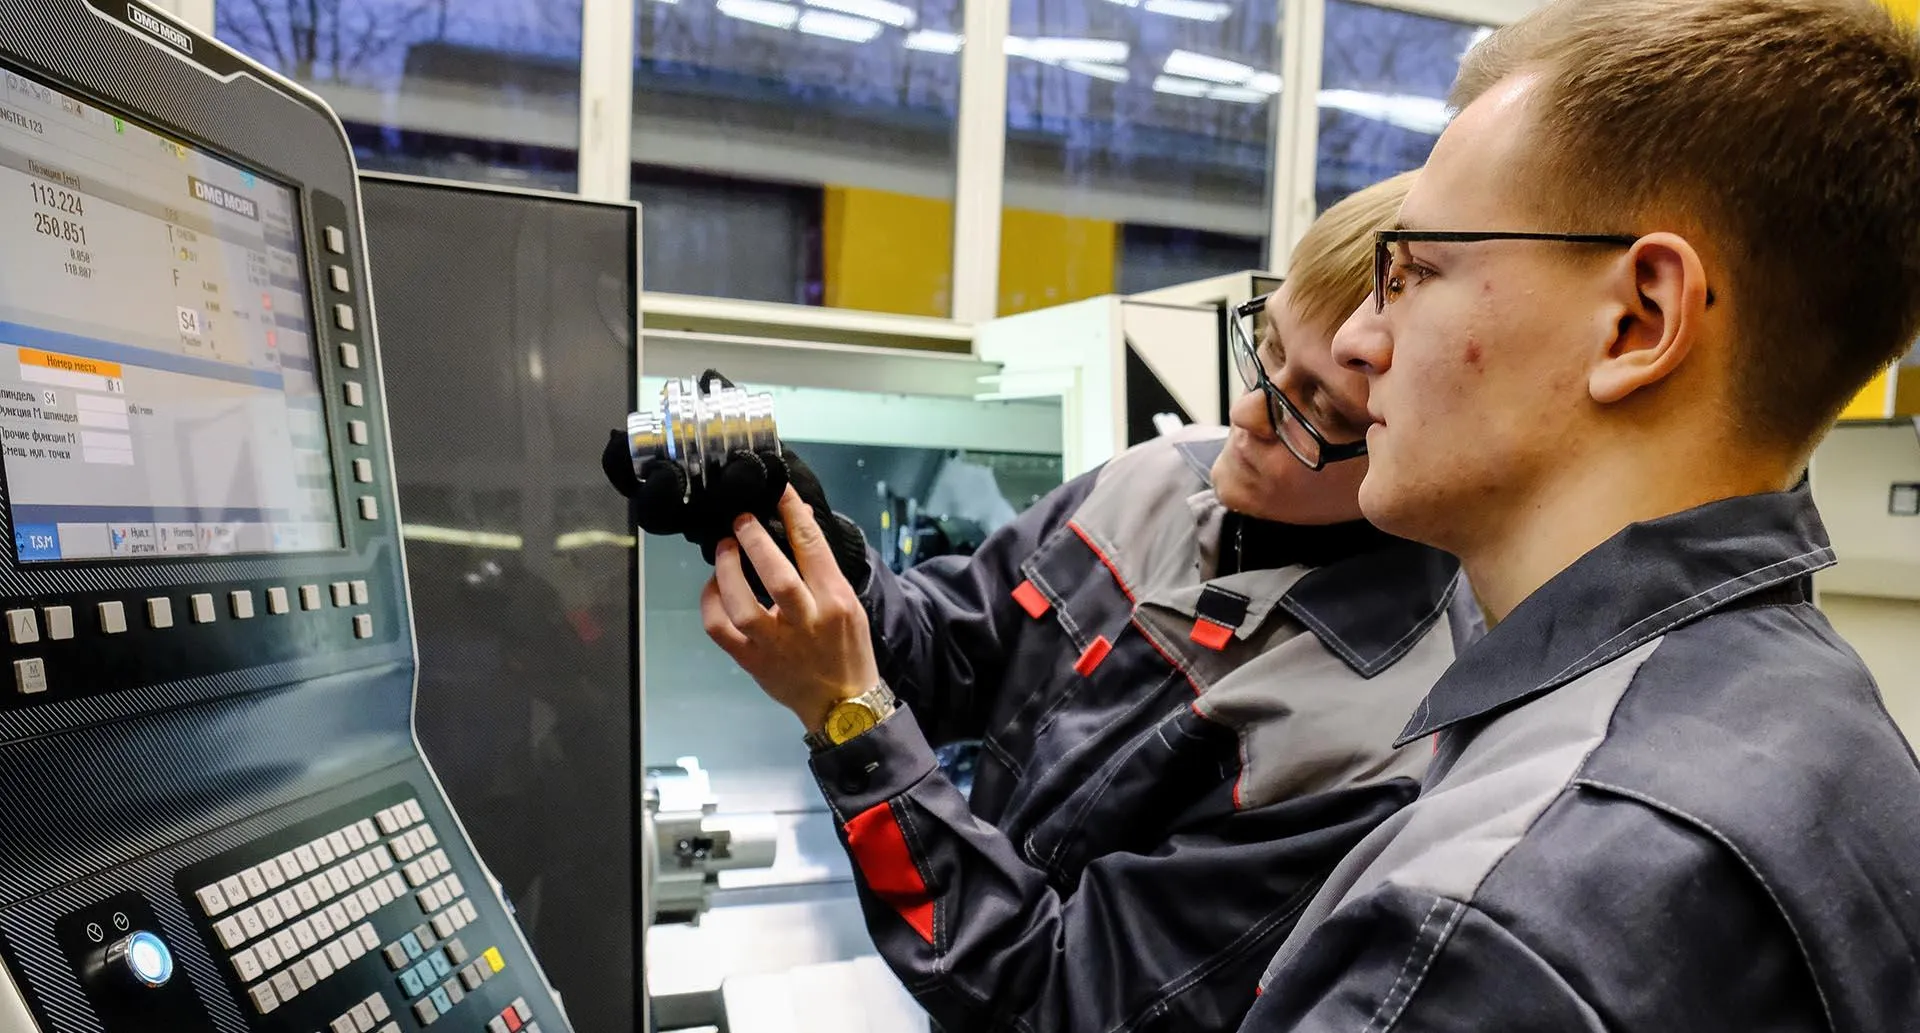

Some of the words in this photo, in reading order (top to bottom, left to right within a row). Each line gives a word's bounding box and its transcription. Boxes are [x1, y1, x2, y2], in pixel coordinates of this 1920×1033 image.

[133, 9, 160, 33] DMG
[160, 23, 188, 48] MORI
[30, 181, 84, 217] 113.224
[194, 180, 224, 206] DMG
[223, 192, 255, 217] MORI
[34, 211, 86, 246] 250.851
[181, 311, 196, 331] S4
[46, 354, 73, 371] Номер
[74, 363, 97, 374] места
[0, 389, 36, 403] пиндель
[44, 392, 56, 405] S4
